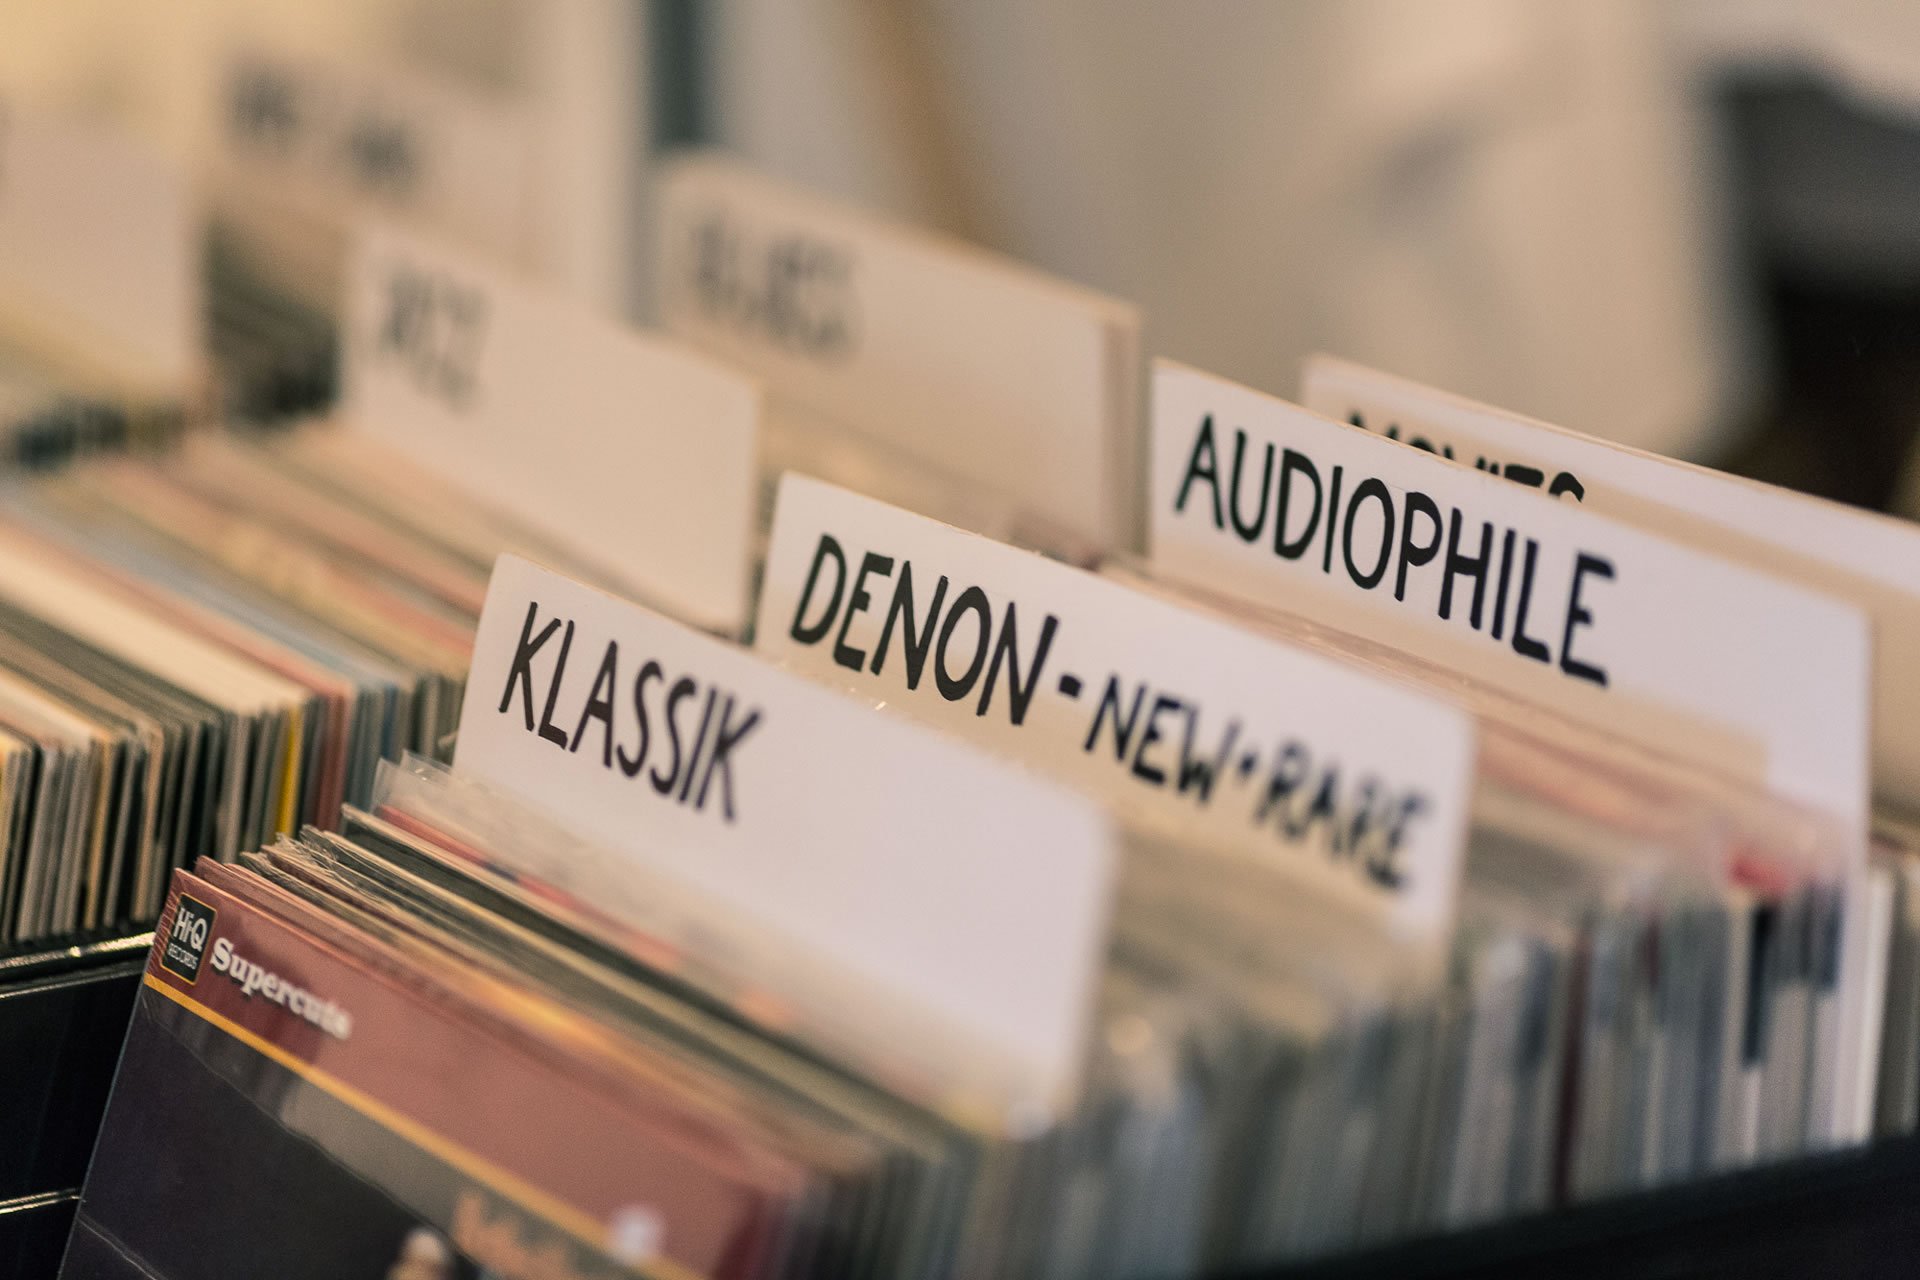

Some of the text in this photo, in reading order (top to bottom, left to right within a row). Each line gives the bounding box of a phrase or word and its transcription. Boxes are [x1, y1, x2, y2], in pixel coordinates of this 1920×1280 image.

[790, 533, 1058, 725] DENON
[1083, 672, 1243, 808] NEW
[1175, 414, 1617, 687] AUDIOPHILE
[498, 601, 763, 824] KLASSIK
